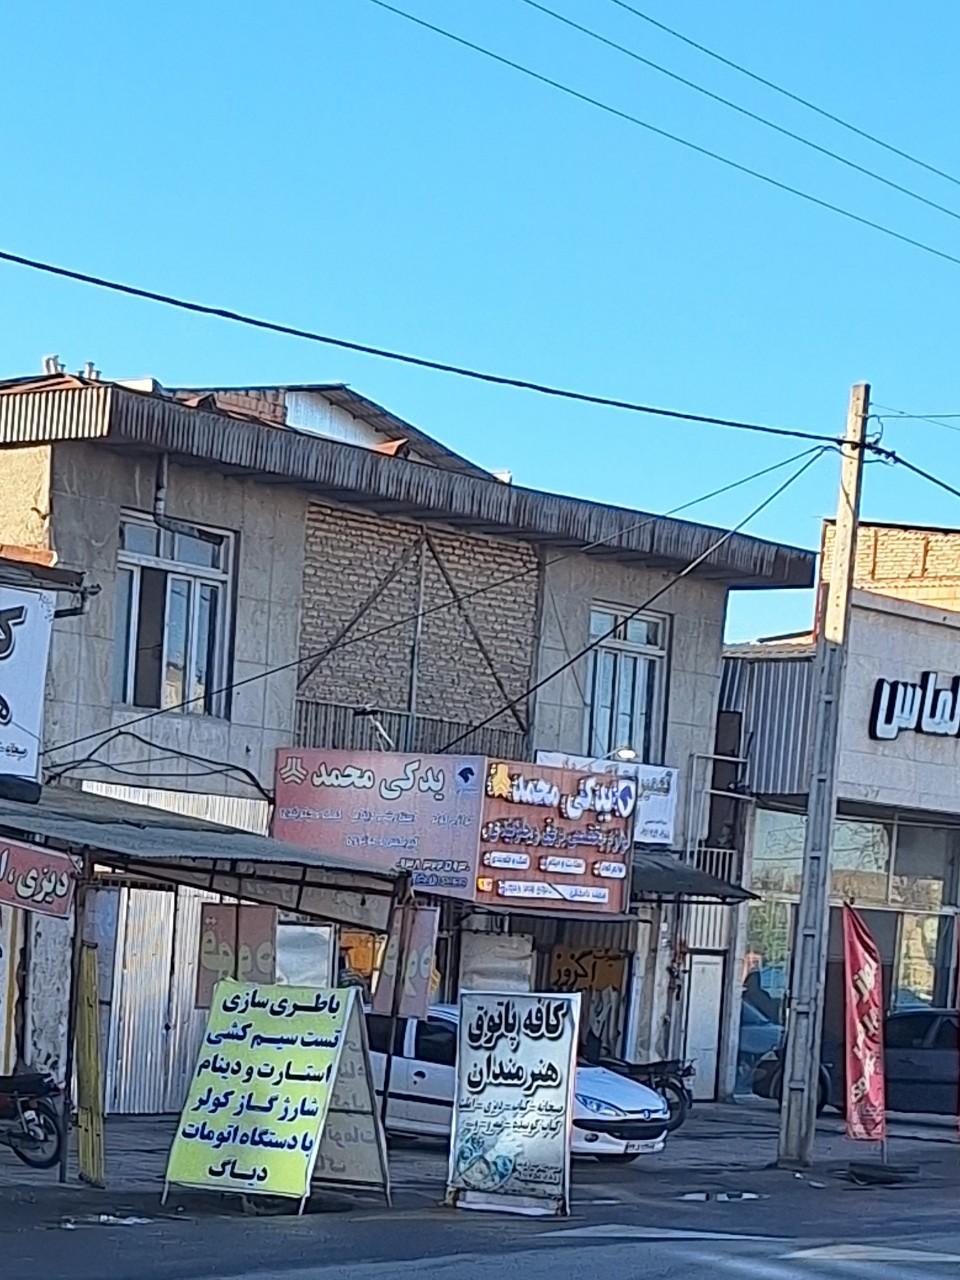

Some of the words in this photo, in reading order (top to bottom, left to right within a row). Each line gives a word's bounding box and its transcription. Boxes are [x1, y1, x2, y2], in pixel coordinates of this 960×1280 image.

[311, 762, 376, 790] محمد
[379, 759, 446, 801] یدکی
[512, 774, 560, 808] محمد
[222, 989, 269, 1013] سازی
[270, 992, 341, 1019] باطری
[467, 998, 517, 1050] پاتوق
[522, 998, 568, 1039] کافه
[206, 1022, 252, 1045] کشی
[250, 1031, 300, 1050] سیم
[300, 1029, 342, 1049] تست
[196, 1053, 242, 1078] دینام
[241, 1066, 254, 1083] و
[257, 1061, 332, 1085] استارت
[466, 1053, 561, 1095] هنرمندان
[191, 1087, 235, 1113] کولر
[233, 1092, 279, 1116] گاز
[277, 1096, 319, 1122] شارژ
[181, 1121, 239, 1149] اتومات
[239, 1129, 299, 1150] دستگاه
[300, 1132, 314, 1158] با
[208, 1159, 269, 1186] دیاگ
